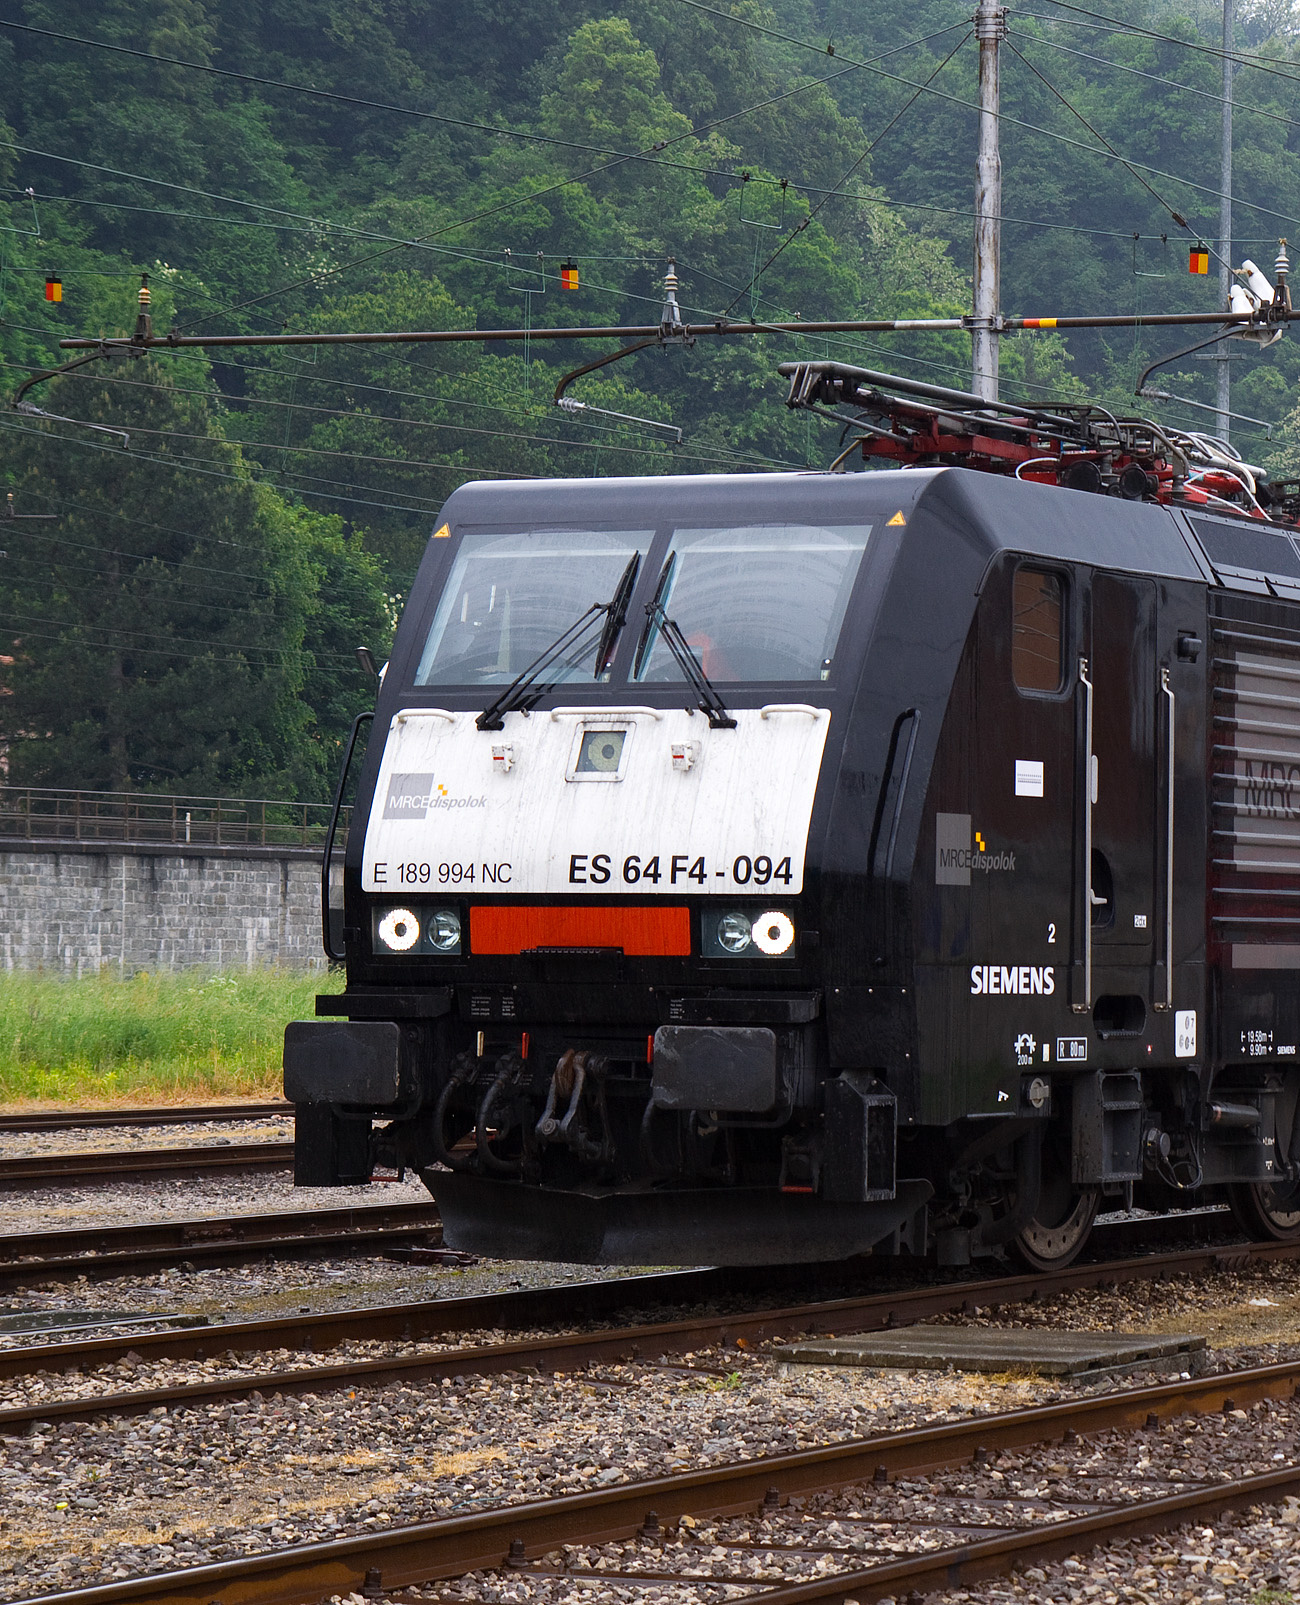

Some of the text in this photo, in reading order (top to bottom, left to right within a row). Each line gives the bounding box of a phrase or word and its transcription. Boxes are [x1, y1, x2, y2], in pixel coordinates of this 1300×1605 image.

[389, 794, 487, 811] MRCEdispolok
[569, 854, 611, 885] ES
[622, 855, 661, 885] 64
[670, 855, 708, 885] F4
[732, 856, 793, 886] 094
[939, 847, 1016, 874] MRCEdispolok
[373, 862, 513, 884] E 189 994 NC
[1047, 922, 1056, 944] 2
[970, 964, 1055, 996] SIEMENS
[1059, 1041, 1065, 1058] R
[1276, 1045, 1296, 1056] SIEMENS
